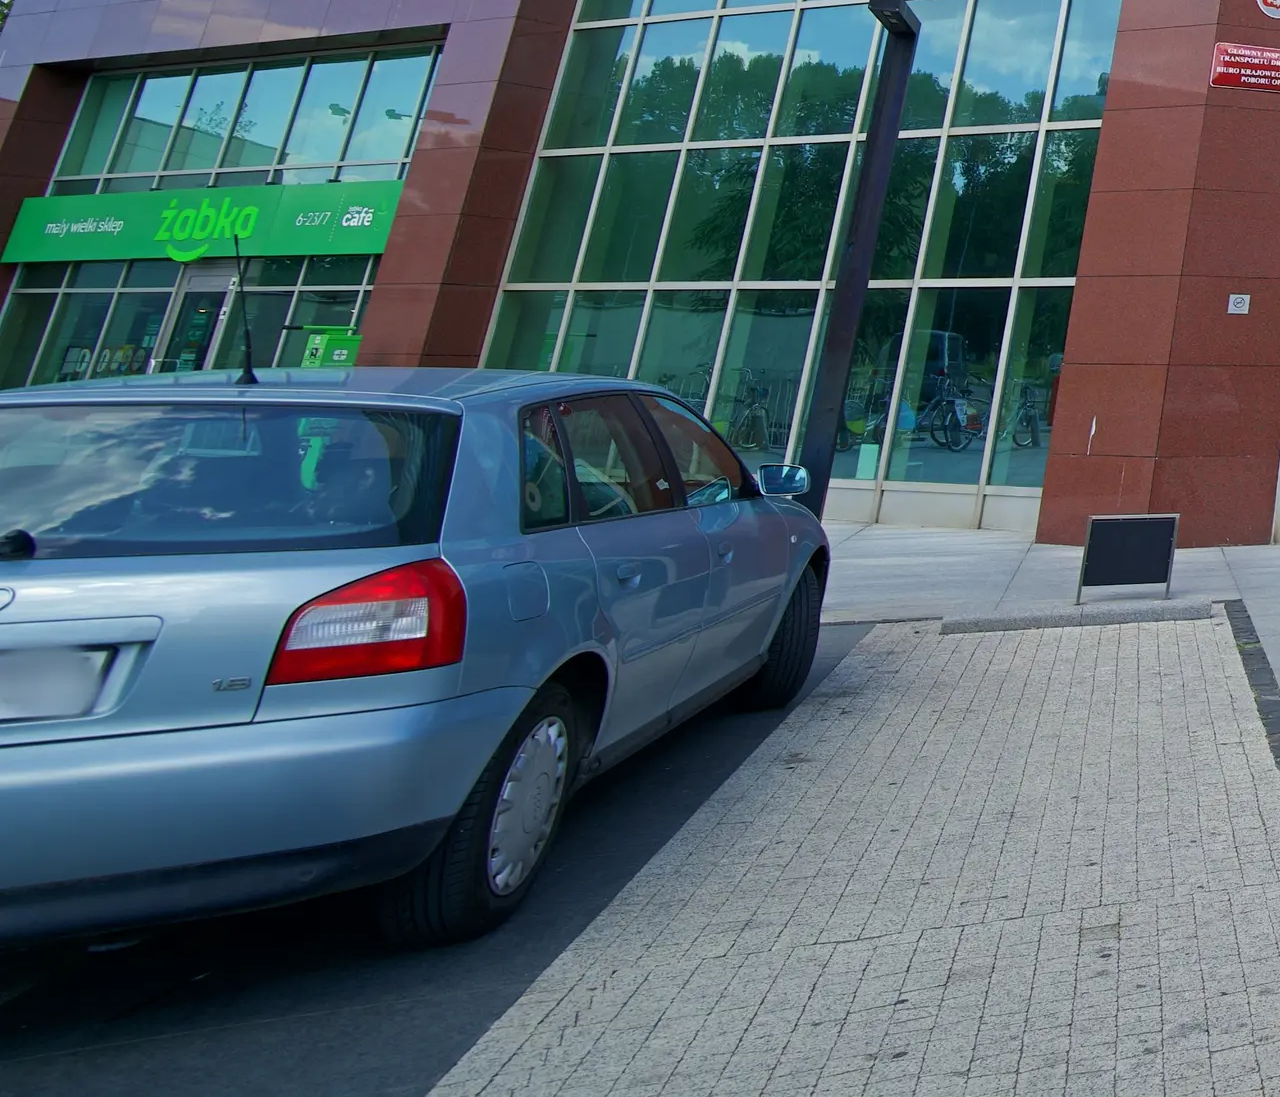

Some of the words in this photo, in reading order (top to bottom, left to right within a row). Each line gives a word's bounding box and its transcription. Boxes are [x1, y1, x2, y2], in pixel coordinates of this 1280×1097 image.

[1228, 47, 1262, 57] GŁÓWNY
[1220, 55, 1269, 65] TRANSPORTU
[1216, 66, 1240, 74] BIURO
[1241, 76, 1271, 85] POBORU
[153, 197, 260, 241] żabka
[342, 207, 375, 226] café
[70, 217, 99, 233] wielki
[97, 216, 124, 236] sklep
